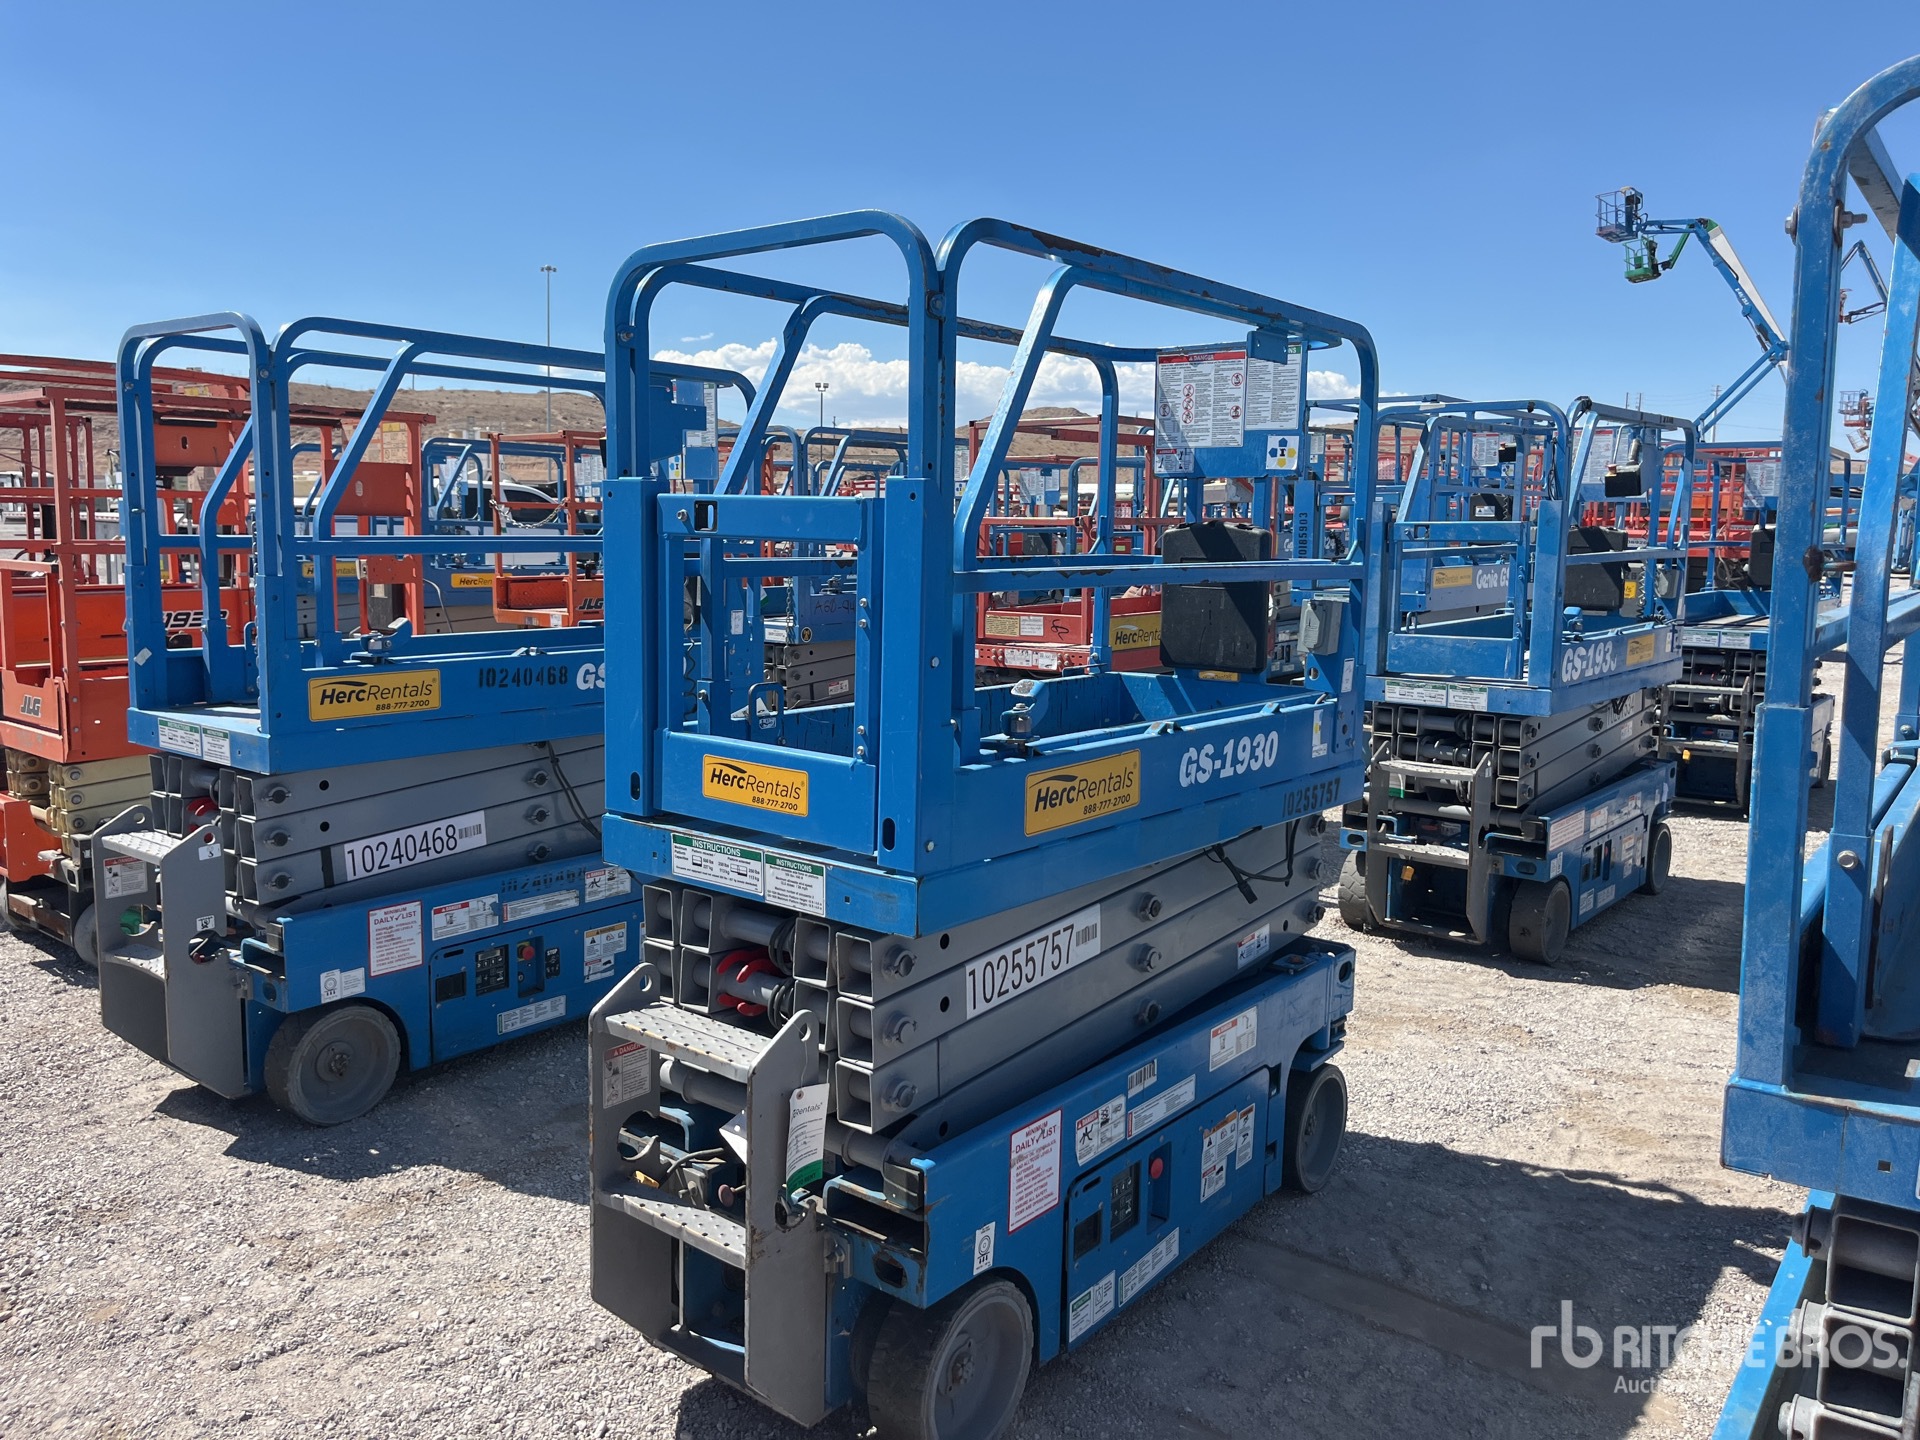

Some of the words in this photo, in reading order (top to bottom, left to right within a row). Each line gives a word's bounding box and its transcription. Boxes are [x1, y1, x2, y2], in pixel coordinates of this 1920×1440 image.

[478, 665, 568, 688] 10240468
[320, 680, 433, 705] HercRentals
[20, 694, 42, 718] JLG
[376, 699, 430, 711] 888-777-2700
[1179, 730, 1279, 788] GS-1930
[710, 768, 802, 800] HercRentals
[1034, 767, 1134, 812] HercRentals
[752, 796, 798, 811] 888-777-2700
[1083, 793, 1131, 815] 888-777-2700
[1282, 777, 1341, 817] 10255757
[347, 824, 458, 877] 10240468
[692, 839, 741, 857] INSTRUCTIONS
[776, 858, 812, 873] INSTRUCTIONS
[374, 915, 394, 925] DAILY
[402, 911, 416, 919] LIST
[384, 907, 407, 915] MINIMUM
[968, 923, 1074, 1010] 10255757
[1016, 1137, 1036, 1153] DAILY
[1042, 1125, 1057, 1140] LIST
